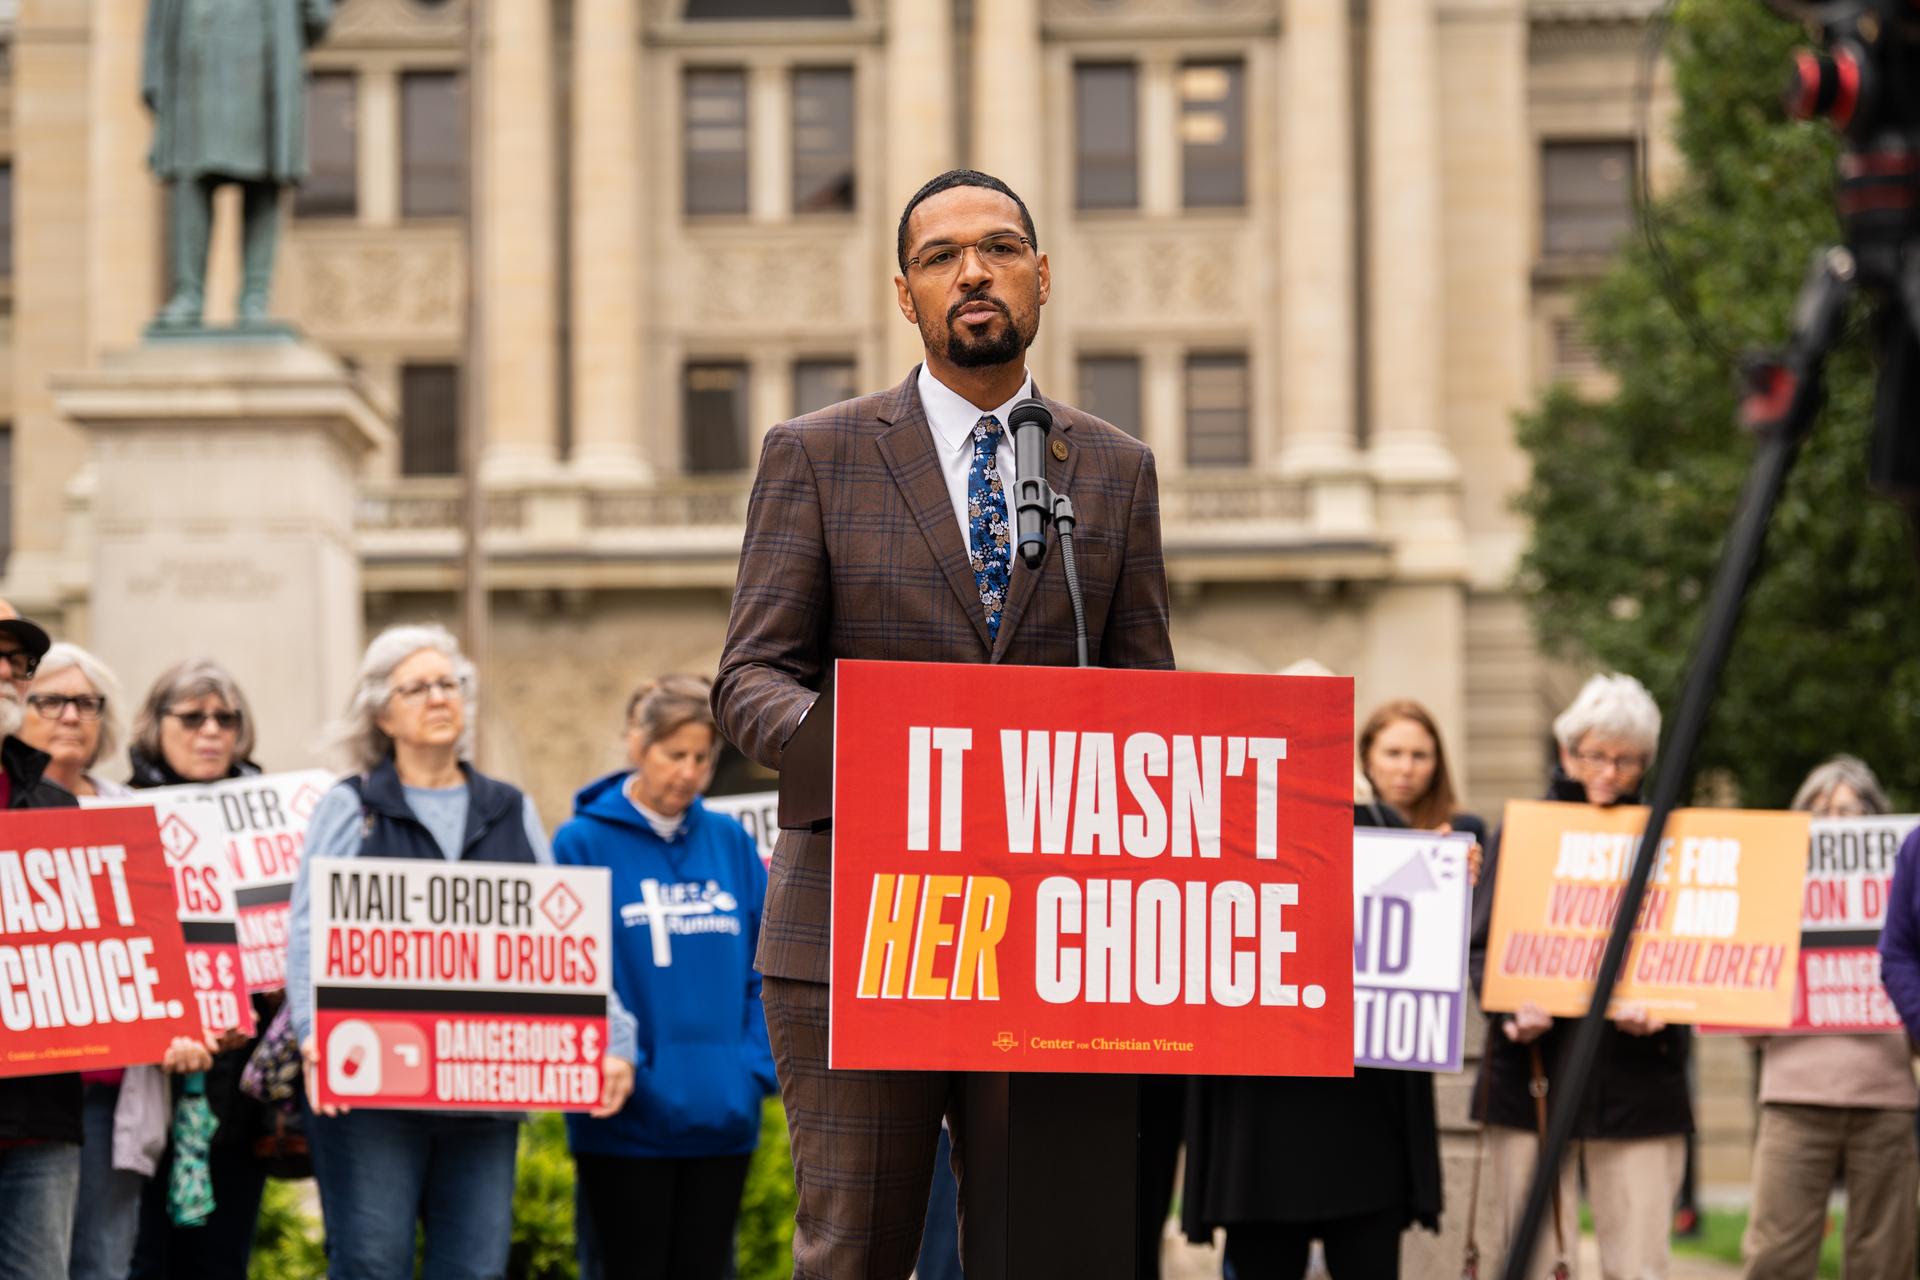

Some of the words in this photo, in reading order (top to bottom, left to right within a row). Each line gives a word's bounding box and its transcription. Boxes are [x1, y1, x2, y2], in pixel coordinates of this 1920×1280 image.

[907, 726, 972, 851] IT
[1000, 729, 1287, 859] WASN'T
[1679, 836, 1740, 885] FOR
[0, 845, 135, 934] ASN'T
[329, 872, 533, 927] MAIL-ORDER
[1671, 887, 1739, 937] AND
[326, 927, 479, 982] ABORTION
[495, 934, 597, 985] DRUGS
[856, 873, 1011, 1000] HER
[1035, 876, 1326, 1008] CHOICE.
[1633, 941, 1787, 989] CHILDREN
[0, 937, 184, 1031] CHOICE.
[435, 1020, 577, 1063] DANGEROUS
[1031, 1037, 1074, 1049] Center
[1091, 1038, 1151, 1051] Christian
[1153, 1039, 1194, 1051] Virtue
[436, 1062, 599, 1104] UNREGULATED
